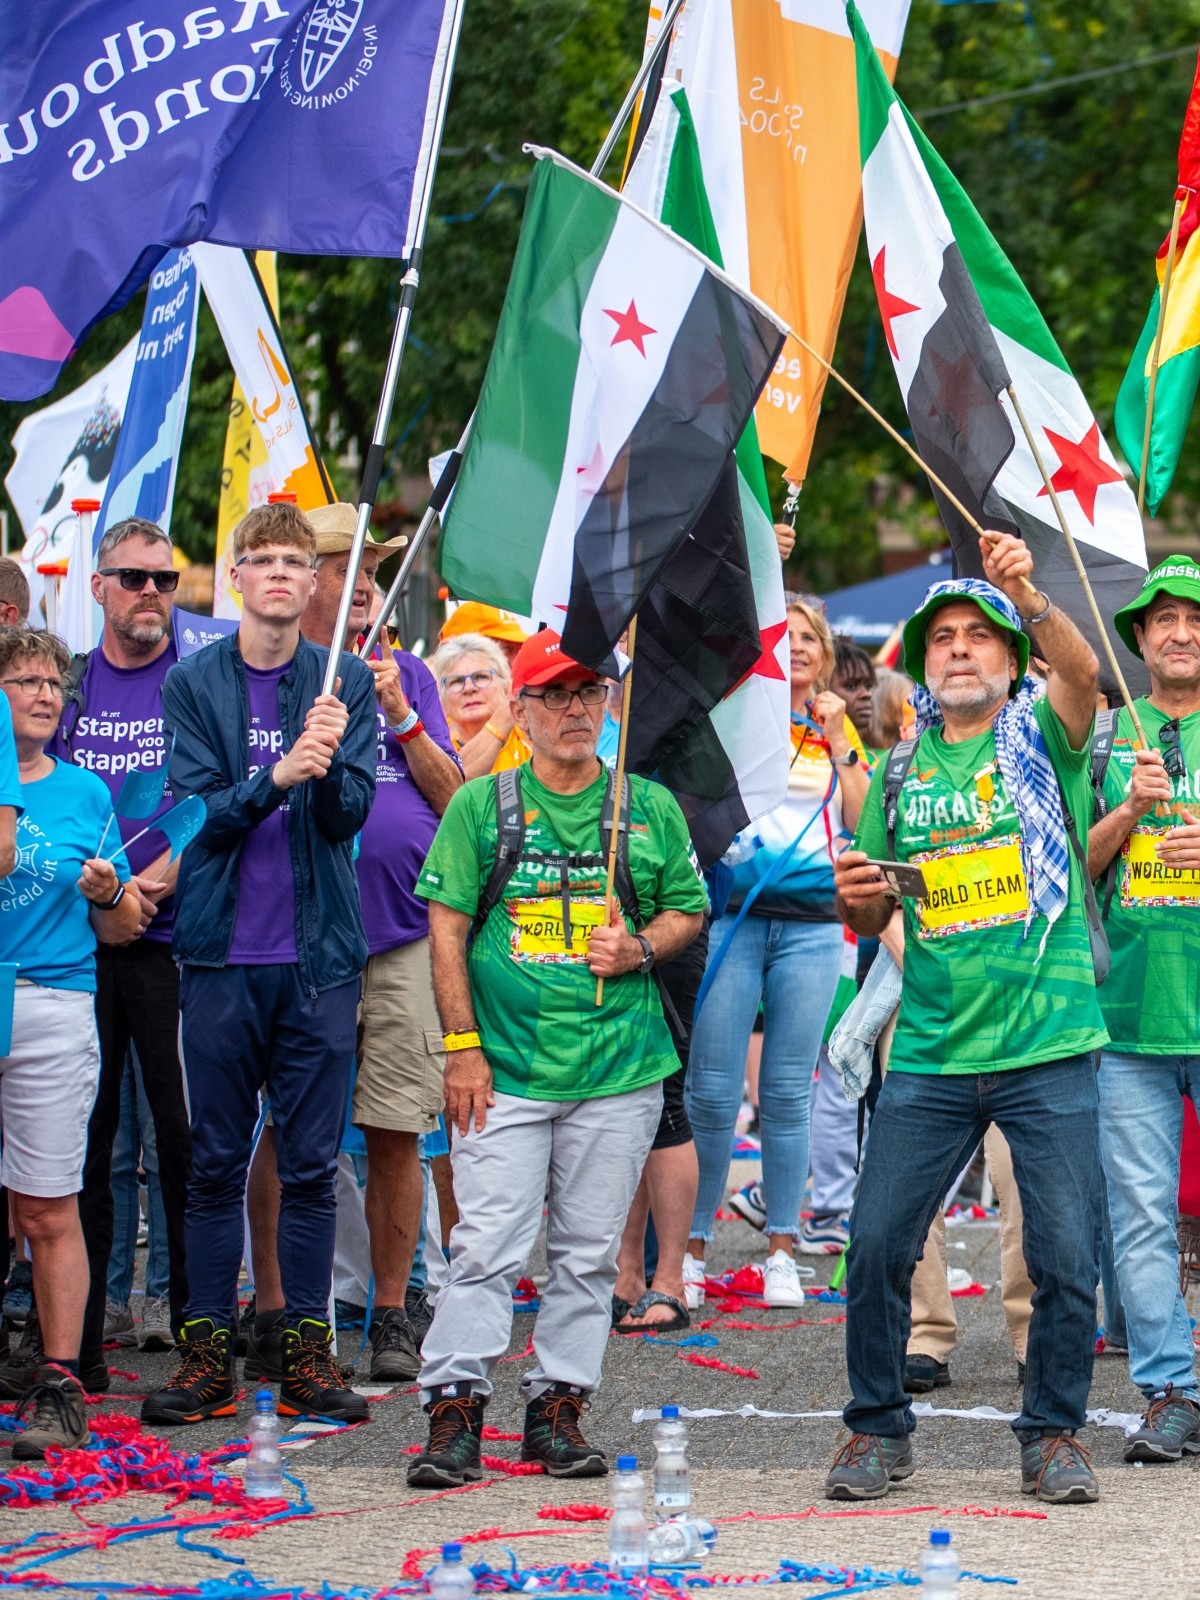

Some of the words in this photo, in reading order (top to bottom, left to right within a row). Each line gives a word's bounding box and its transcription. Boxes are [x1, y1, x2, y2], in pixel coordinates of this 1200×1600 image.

[137, 737, 164, 748] voo
[41, 859, 58, 882] uit
[1132, 861, 1182, 880] WORLD
[0, 881, 44, 912] ereld
[923, 884, 969, 911] WORLD
[973, 873, 1022, 900] TEAM
